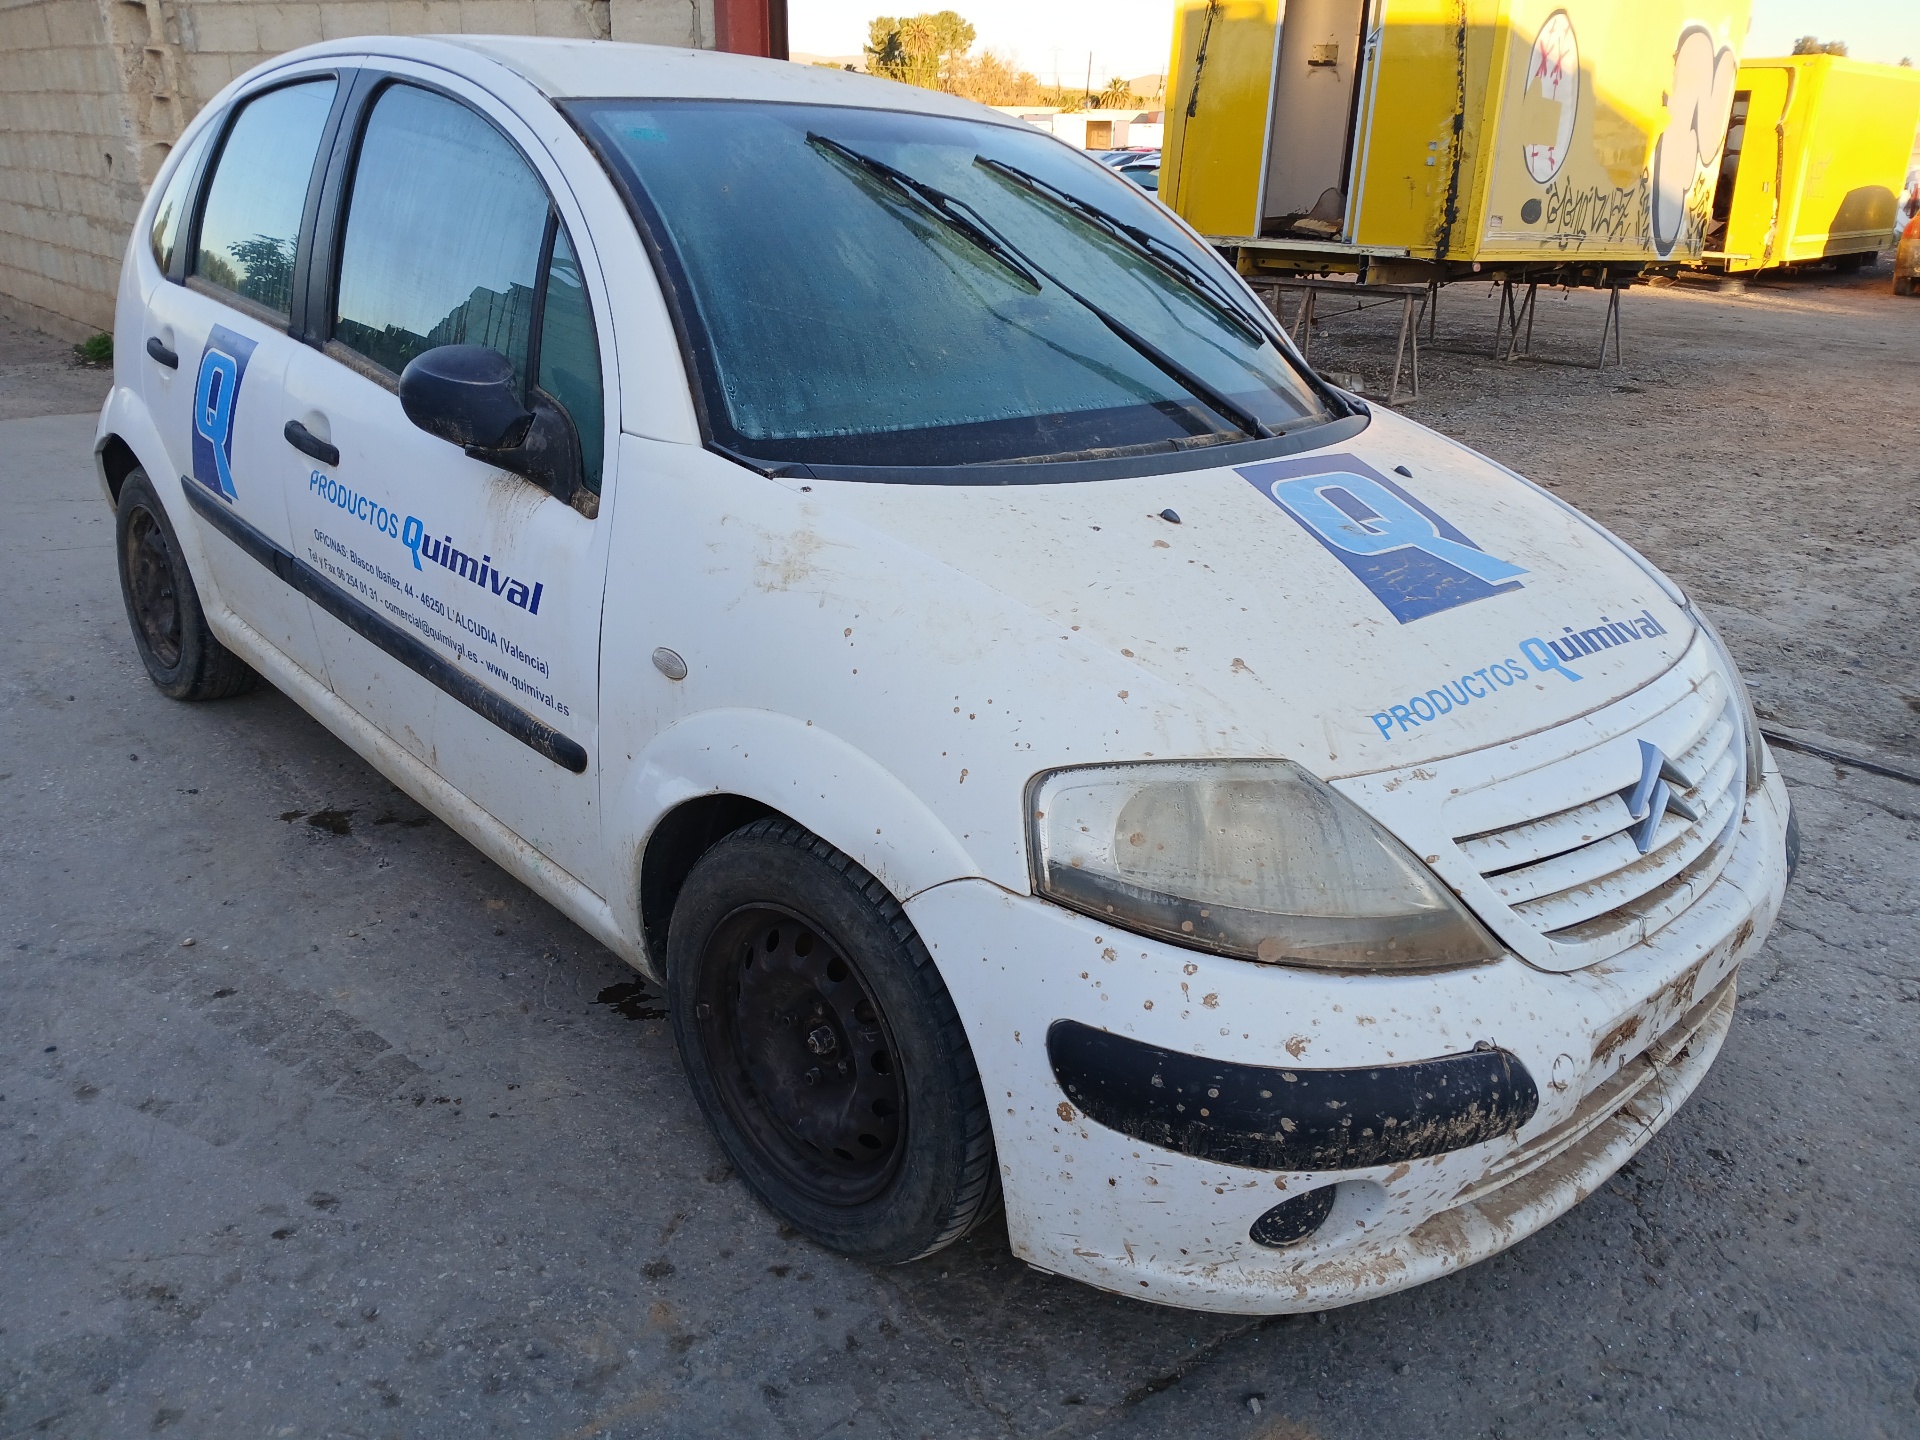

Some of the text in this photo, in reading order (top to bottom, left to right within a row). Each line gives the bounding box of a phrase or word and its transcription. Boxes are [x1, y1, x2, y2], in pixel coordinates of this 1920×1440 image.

[194, 346, 240, 501] Q
[309, 470, 544, 616] PRODUCTOS Quimival
[314, 528, 349, 560] OFICINAS:
[350, 550, 375, 575] Blasco
[376, 565, 403, 594] Ibañez,
[405, 583, 413, 598] 44
[420, 593, 445, 616] 46250
[447, 606, 498, 647] L'ALCUDIA
[500, 637, 549, 679] (Valencia)
[323, 558, 336, 575] Fax
[336, 567, 346, 581] 96
[346, 572, 359, 590] 254
[360, 581, 368, 596] 01
[369, 587, 378, 602] 31
[384, 600, 478, 664] comercial@quimival.es
[485, 660, 570, 717] www.quimival.es
[1371, 609, 1668, 741] PRODUCTOS Quimival
